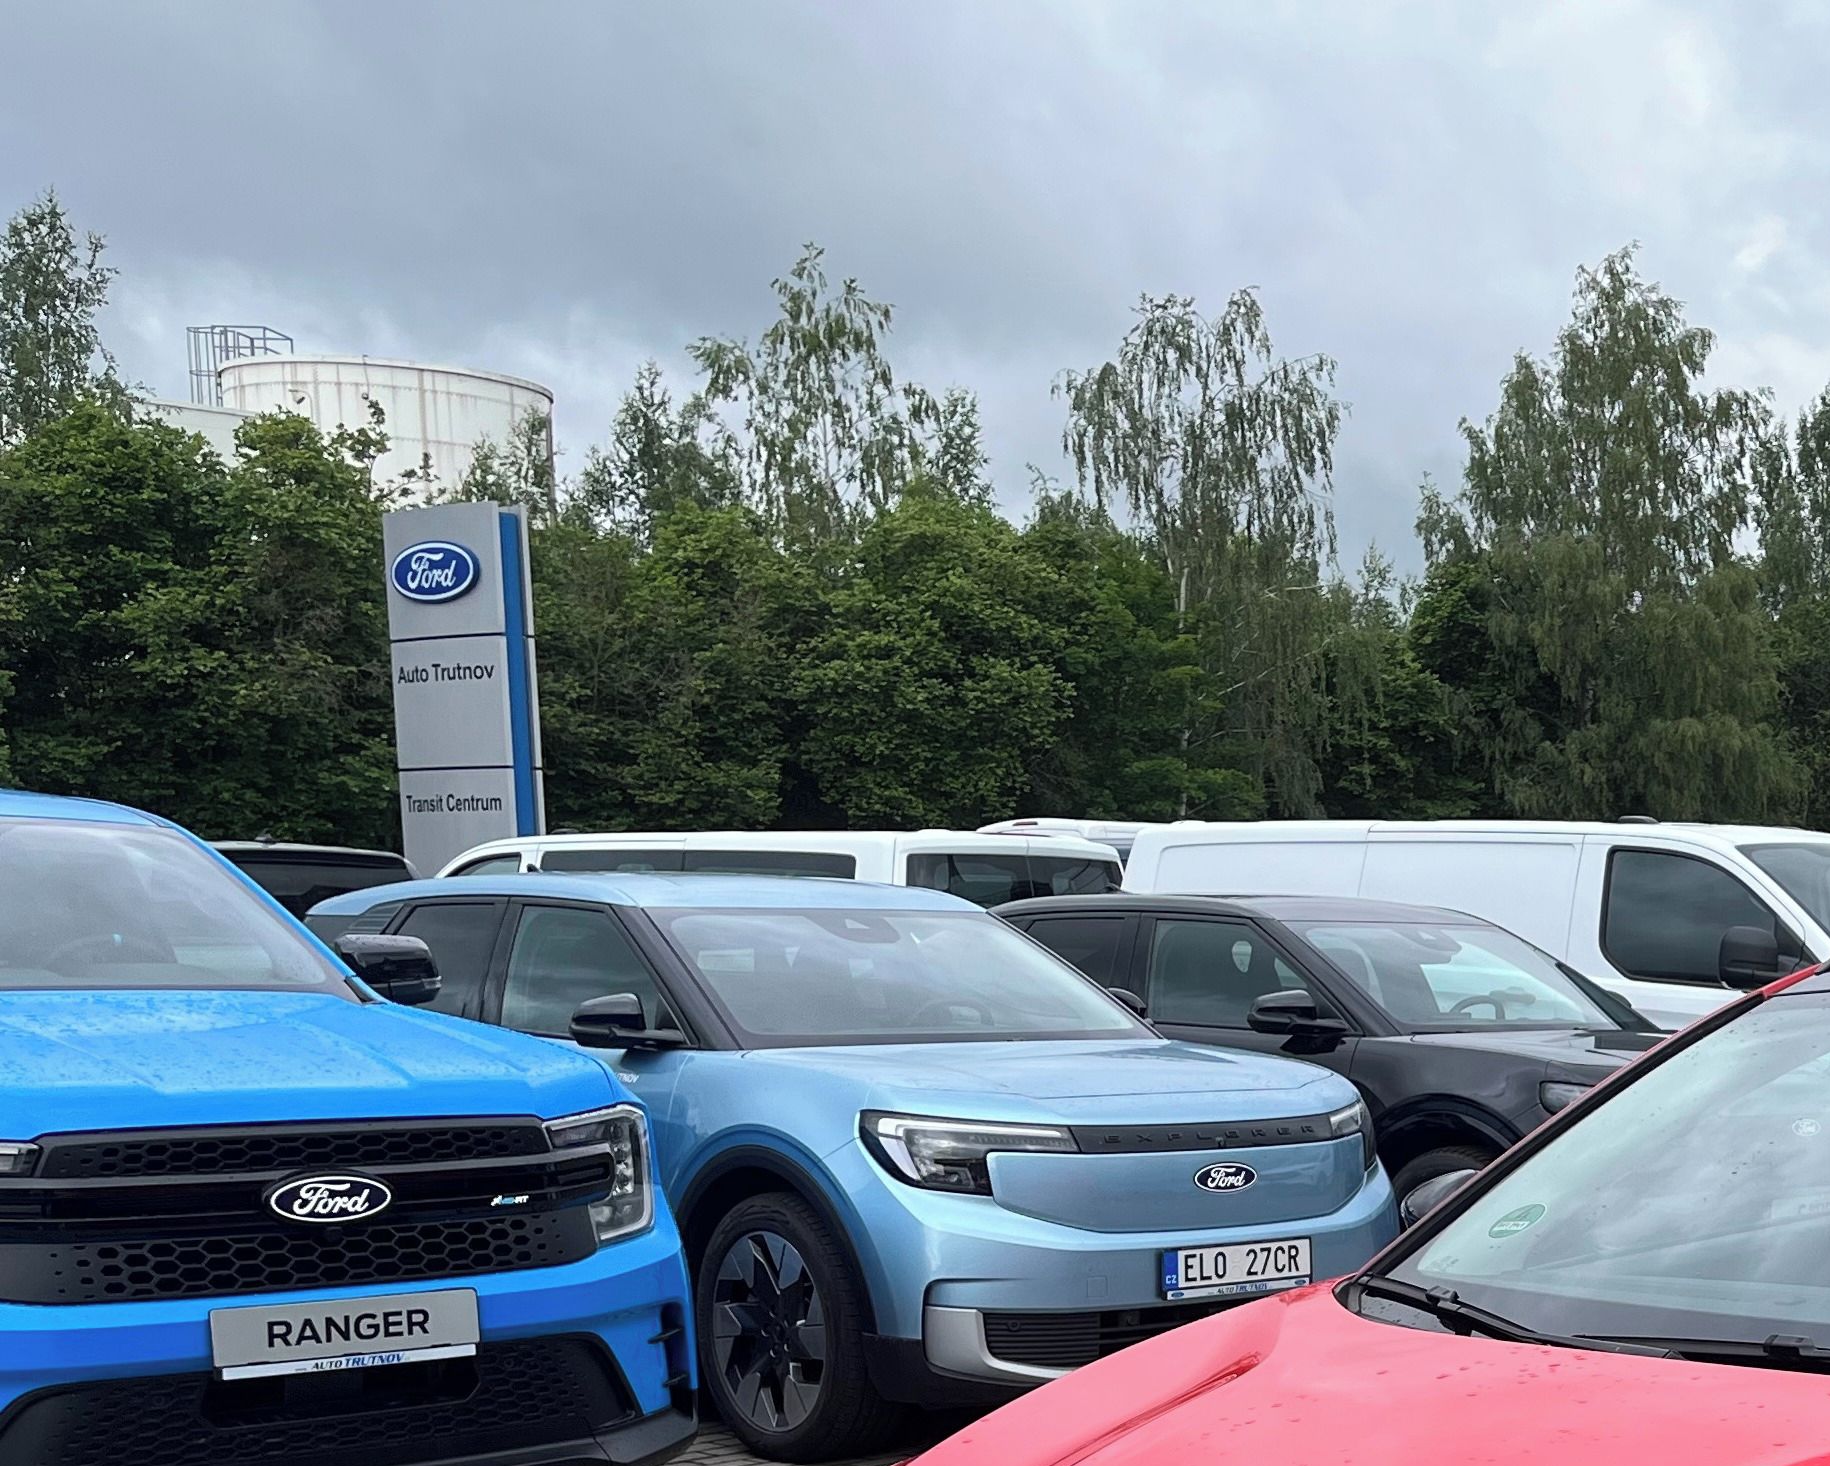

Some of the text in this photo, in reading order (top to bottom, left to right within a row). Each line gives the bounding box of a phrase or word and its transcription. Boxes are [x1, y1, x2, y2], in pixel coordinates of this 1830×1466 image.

[406, 551, 457, 590] Ford
[397, 663, 495, 685] Auto Trutnov
[406, 793, 502, 813] Transit Centrum
[1206, 1167, 1246, 1188] Ford
[292, 1181, 371, 1216] Ford
[1245, 1244, 1300, 1276] 27CR
[1165, 1275, 1178, 1284] CZ
[266, 1308, 431, 1349] RANGER
